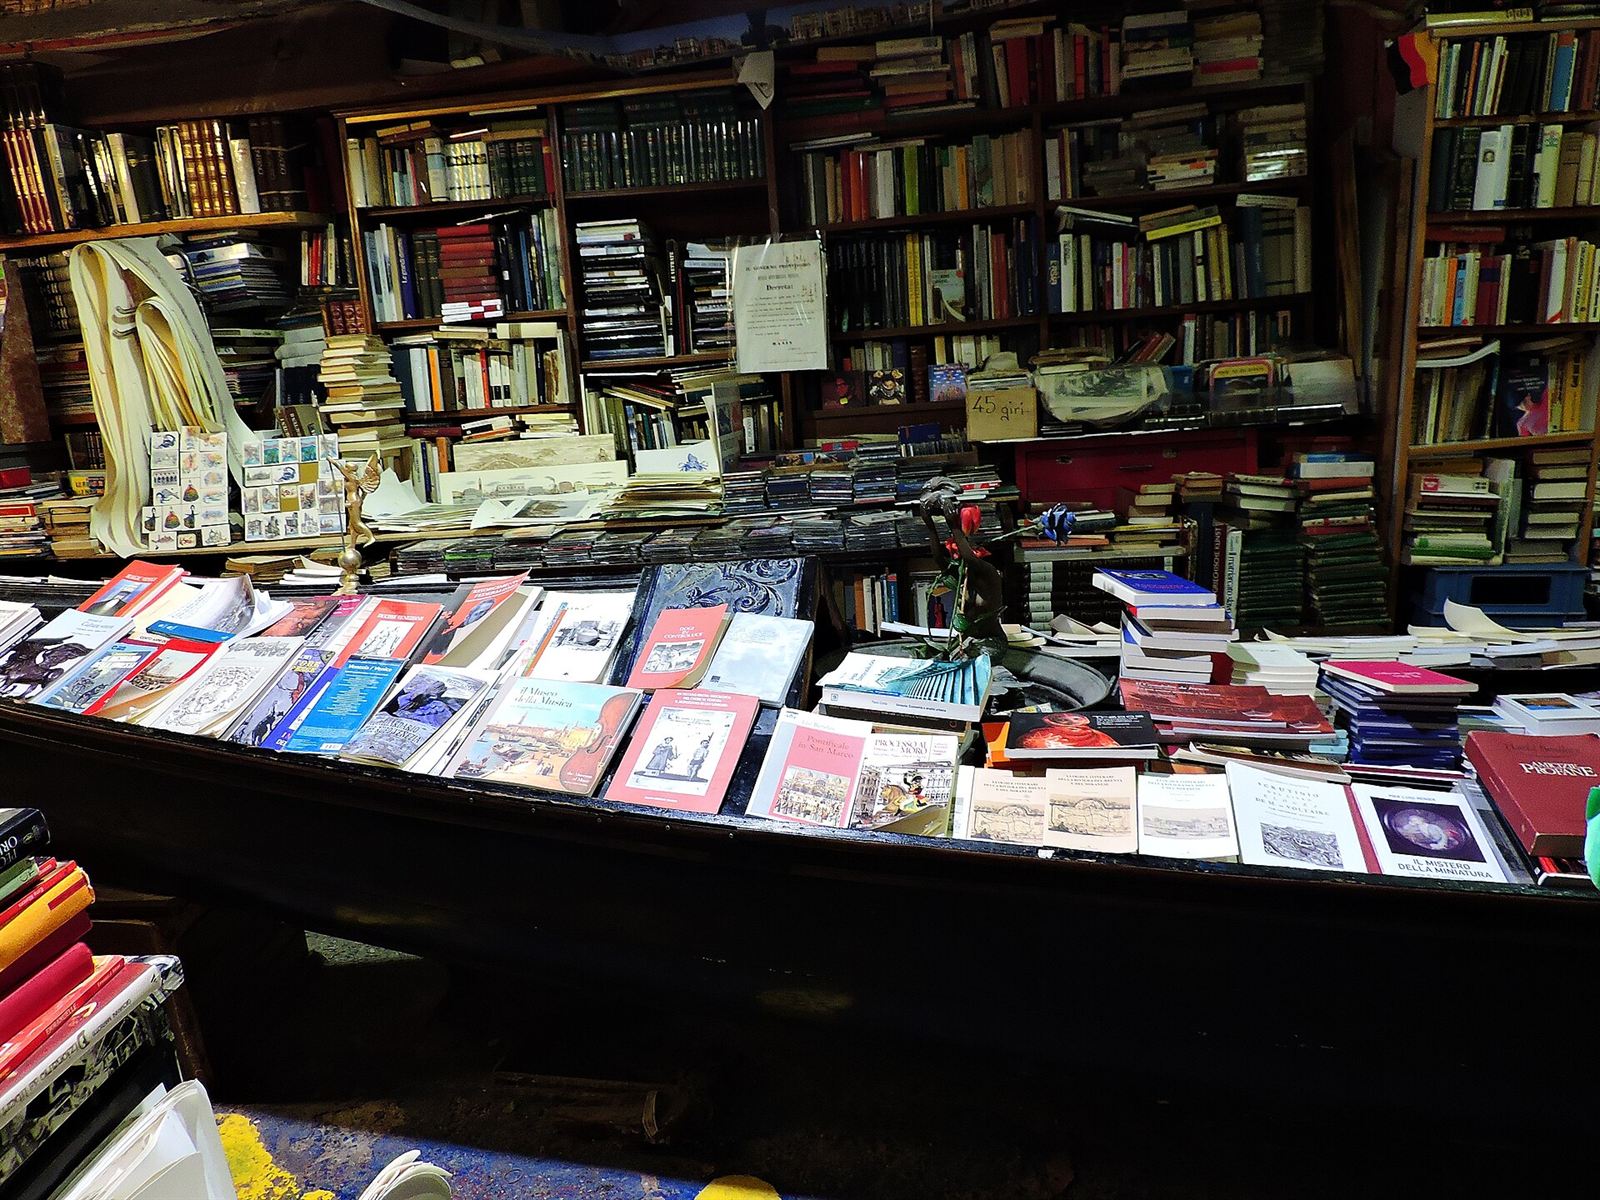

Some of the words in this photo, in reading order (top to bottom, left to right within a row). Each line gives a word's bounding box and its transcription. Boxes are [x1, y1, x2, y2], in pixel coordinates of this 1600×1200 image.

[972, 395, 997, 414] 45
[1000, 401, 1024, 422] giri
[529, 687, 559, 697] Museo
[539, 697, 573, 708] Musica
[806, 735, 850, 749] Pontificale
[808, 742, 824, 752] San
[827, 746, 854, 758] Marco
[900, 746, 928, 755] MORO
[1519, 762, 1598, 777] PROFANE
[1398, 863, 1433, 874] DELLA
[1435, 866, 1493, 879] MINIATURA
[1413, 858, 1424, 866] IL
[1425, 860, 1471, 870] MISTERO
